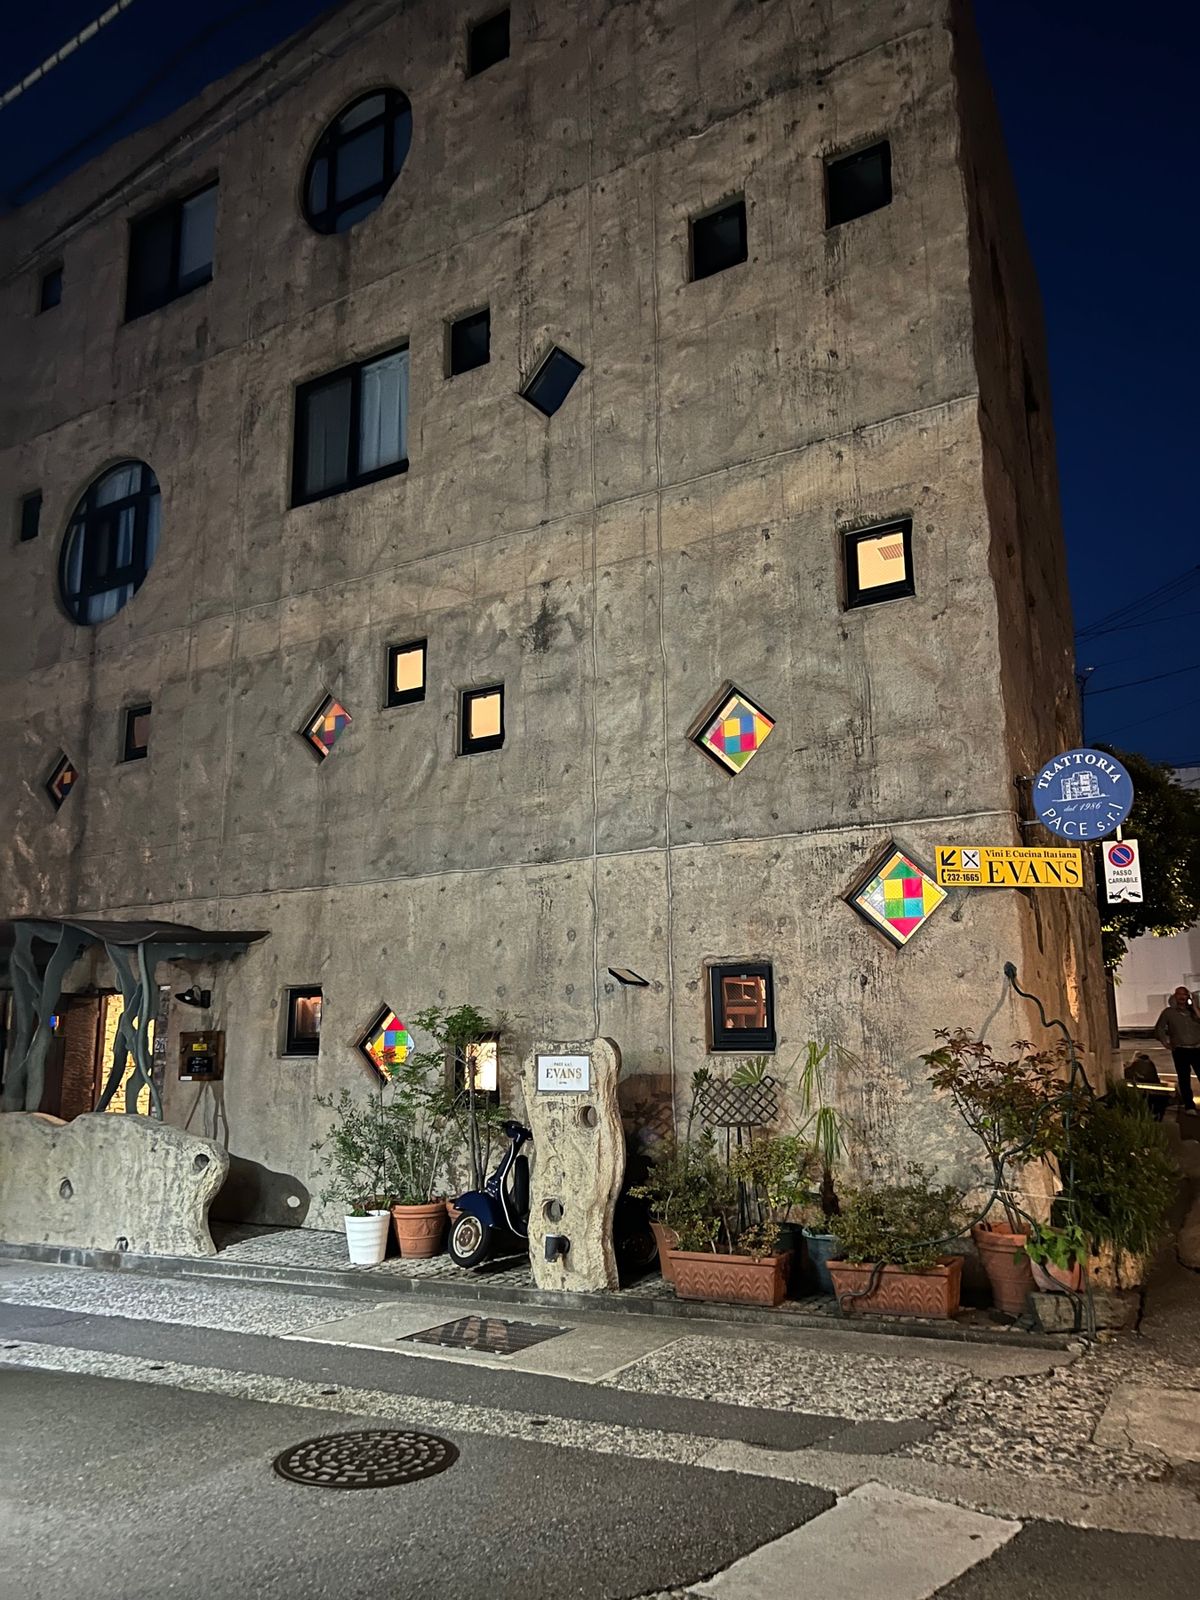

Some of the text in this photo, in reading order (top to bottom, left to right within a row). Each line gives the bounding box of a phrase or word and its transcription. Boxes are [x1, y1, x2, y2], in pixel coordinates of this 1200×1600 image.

[1037, 753, 1122, 790] TRATTORIA
[1063, 801, 1103, 812] dal 1986
[1042, 807, 1088, 836] PACE
[985, 850, 1004, 858] Vini
[1005, 850, 1012, 858] E
[1012, 850, 1042, 858] Cucina
[947, 873, 980, 882] 232-1665
[985, 860, 1079, 885] EVANS
[1108, 876, 1139, 884] CARRABILE
[545, 1067, 582, 1079] EVANS
